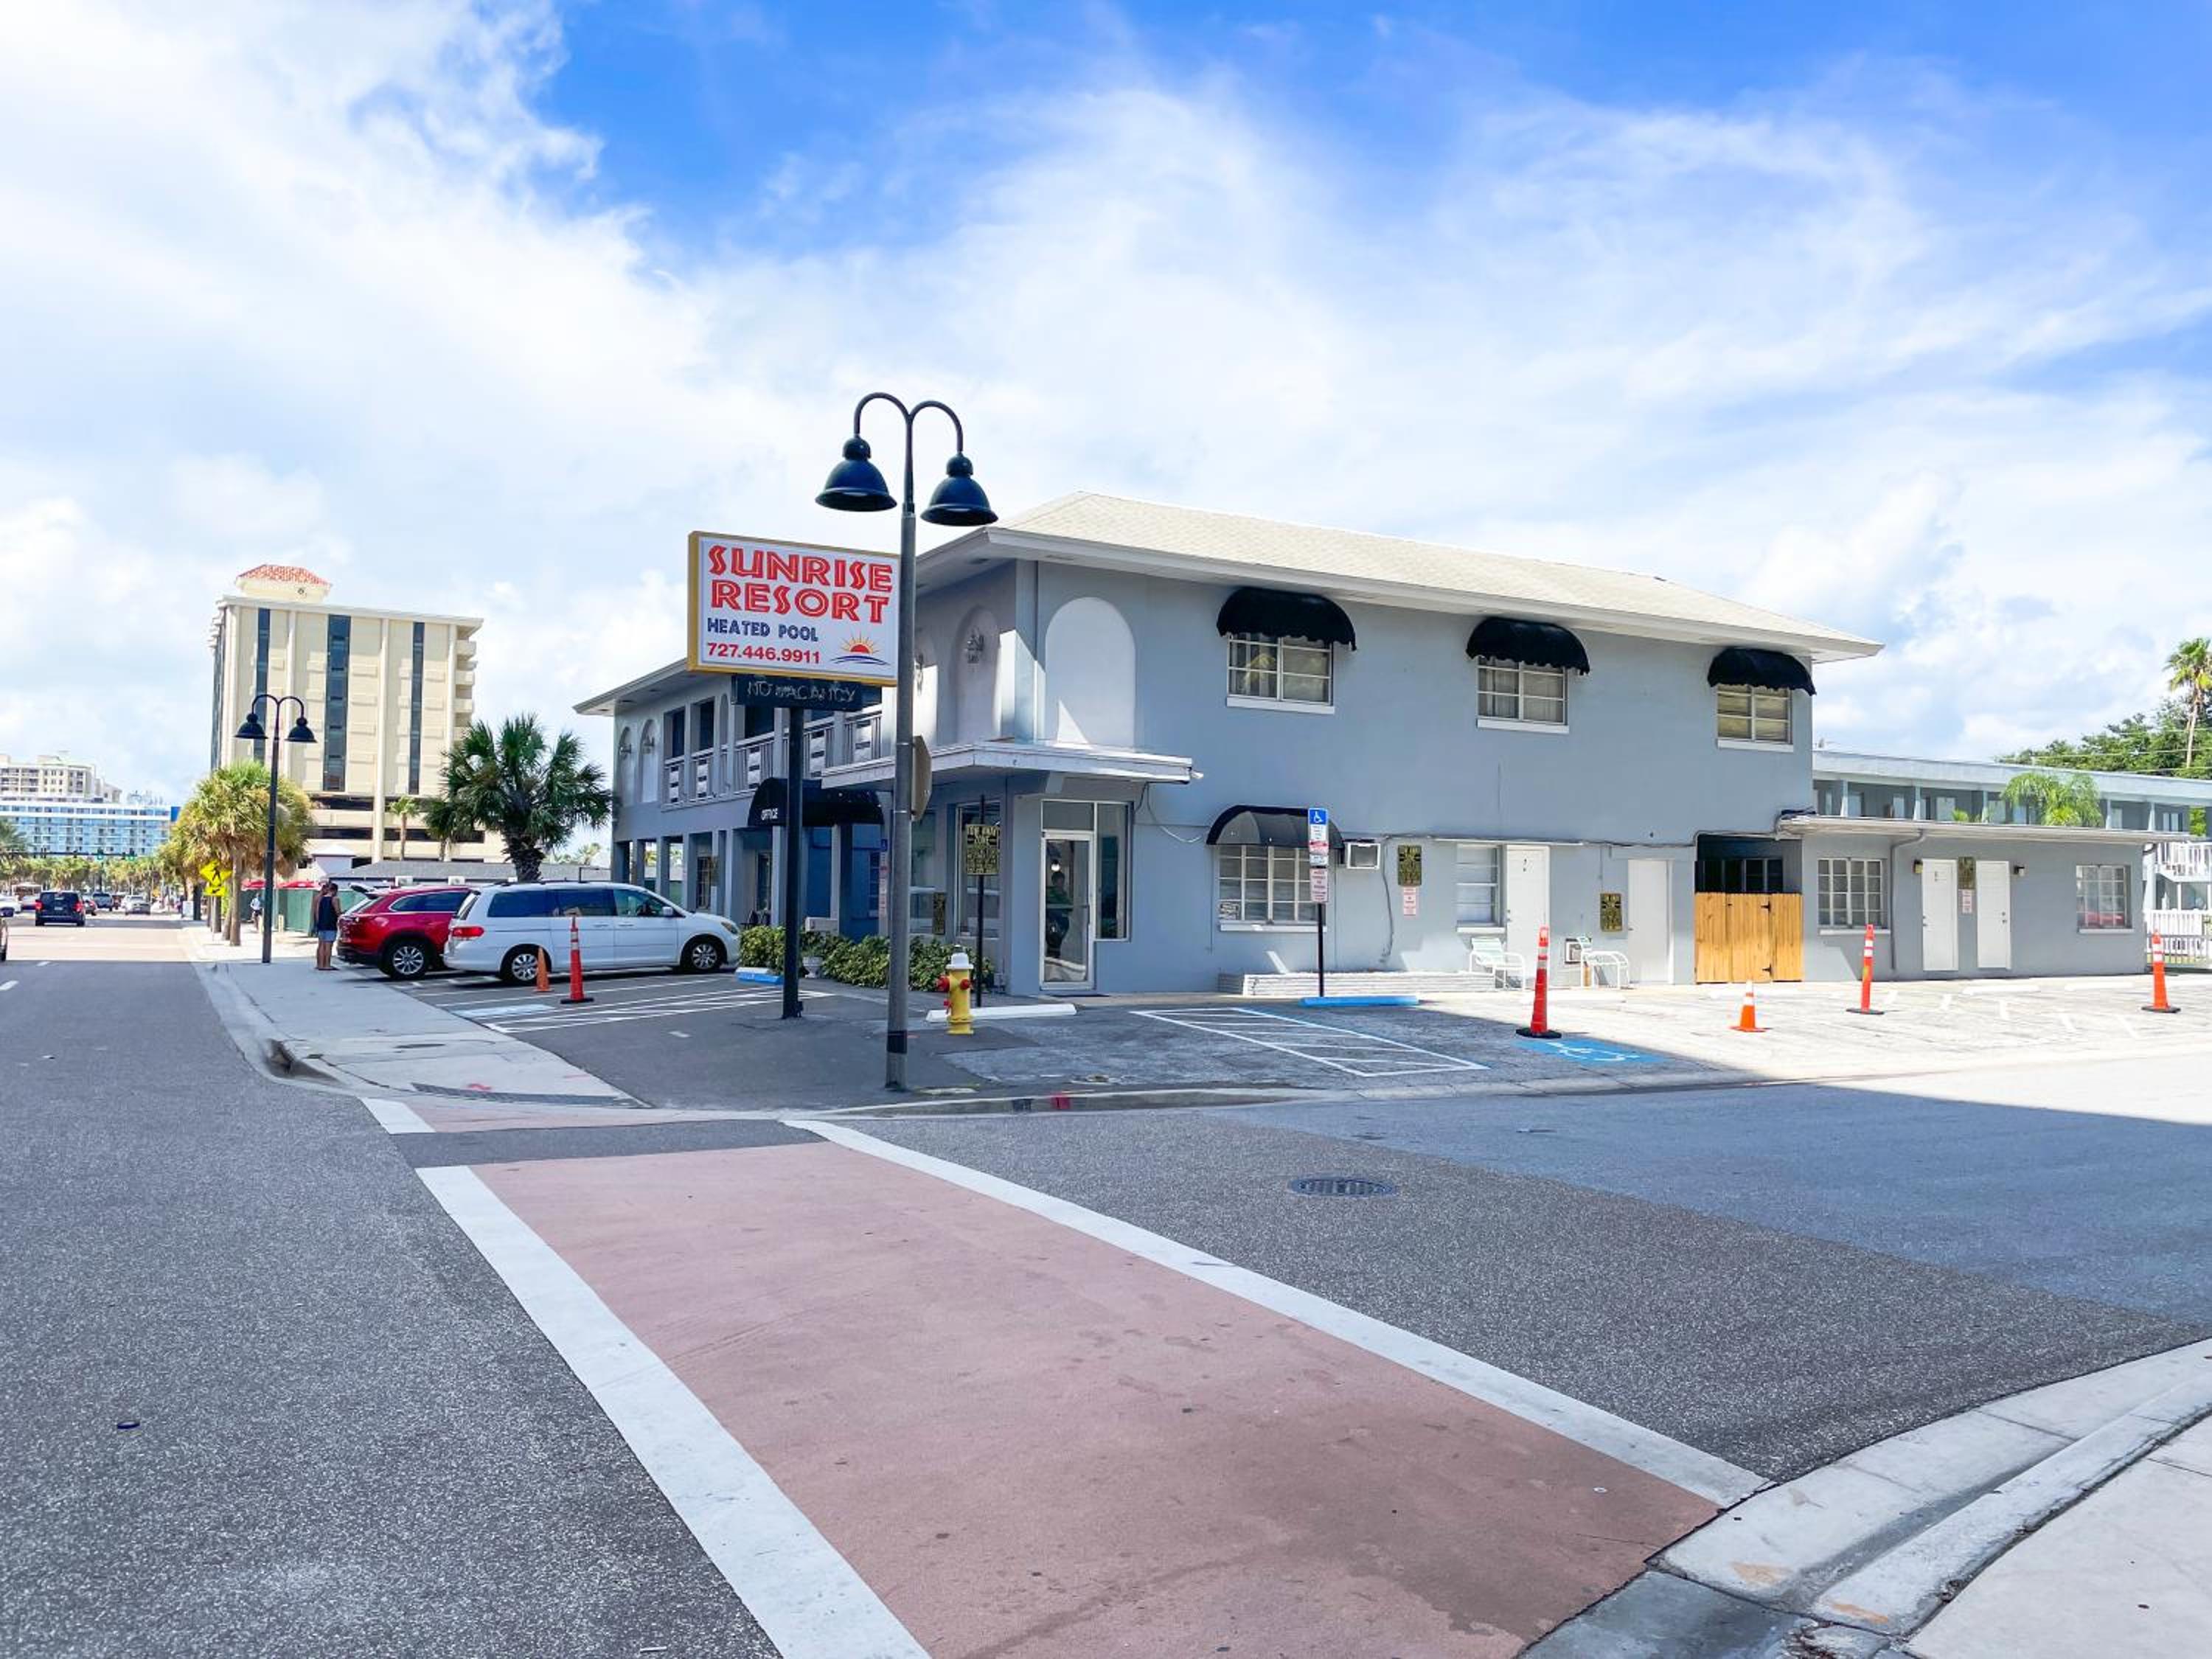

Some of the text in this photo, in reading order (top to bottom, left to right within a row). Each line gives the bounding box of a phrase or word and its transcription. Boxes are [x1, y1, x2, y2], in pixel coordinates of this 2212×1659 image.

[708, 544, 893, 594] SUNRISE
[711, 579, 889, 624] RESORT
[707, 617, 818, 642] HEATED POOL
[707, 642, 820, 664] 727.446.9911
